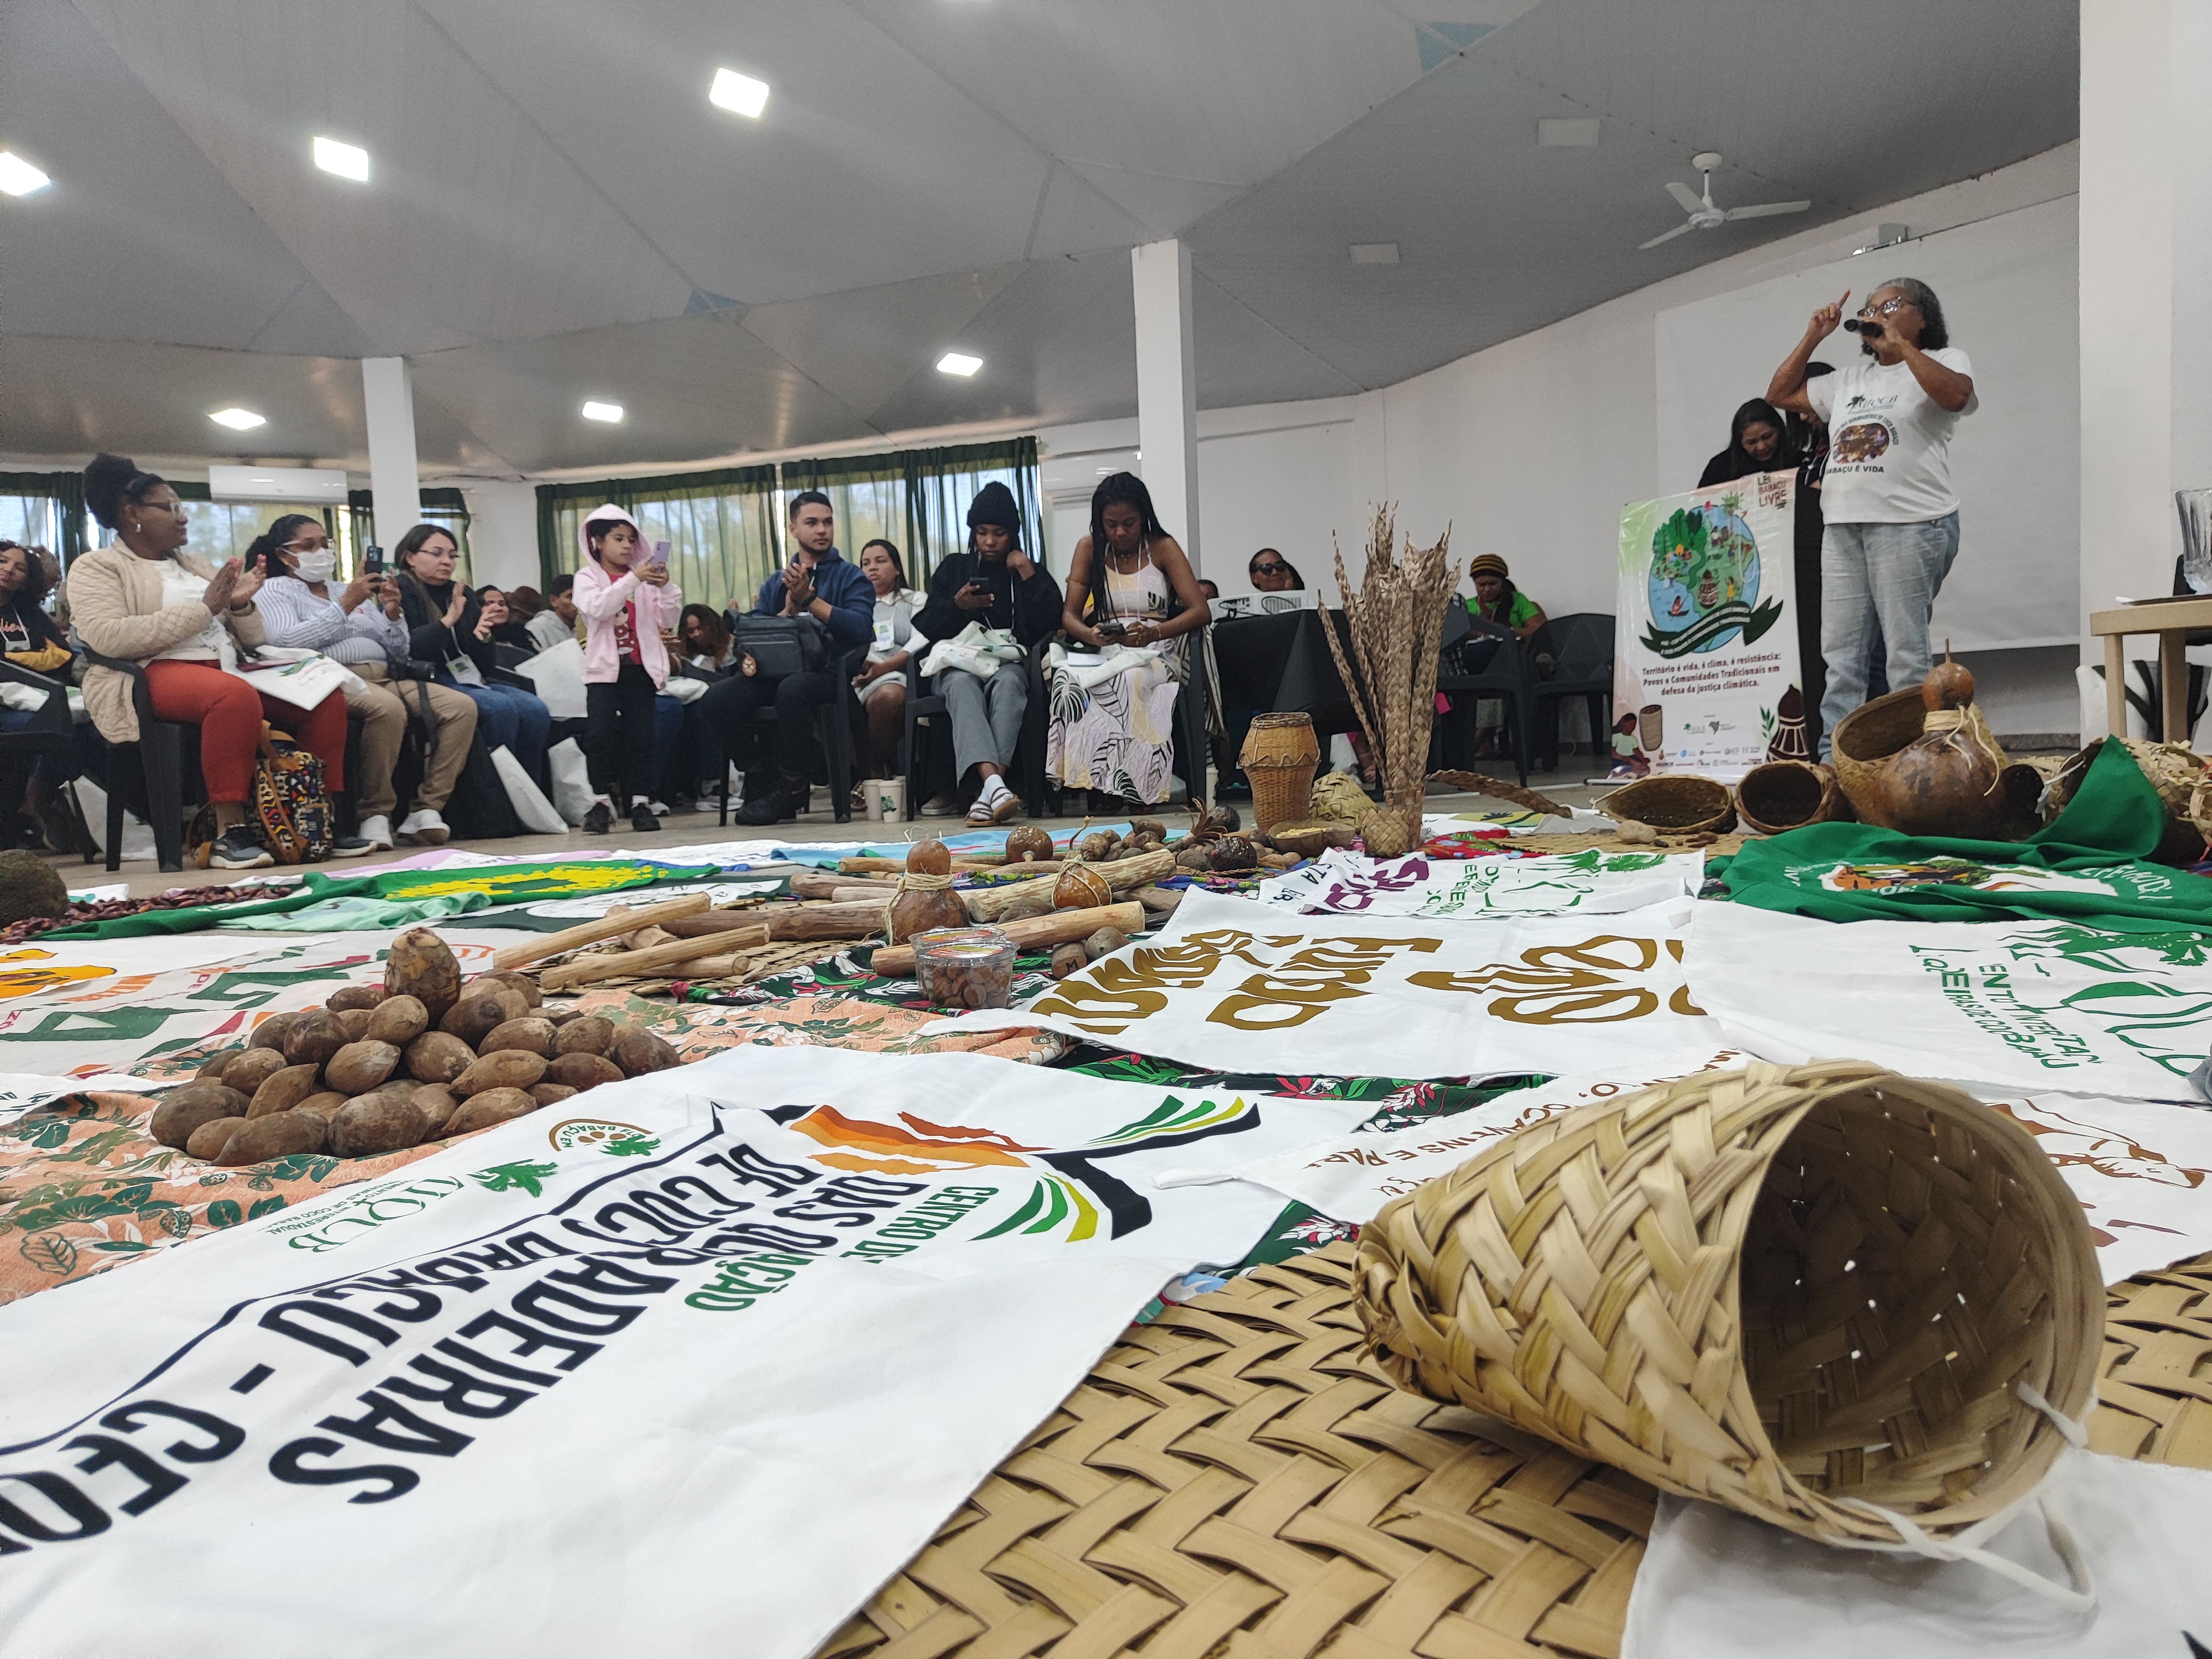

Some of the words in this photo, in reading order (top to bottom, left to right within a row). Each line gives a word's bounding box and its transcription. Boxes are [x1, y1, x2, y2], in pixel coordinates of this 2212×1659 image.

[1759, 489, 1787, 507] LIVRE
[1642, 665, 1674, 676] Território
[1643, 678, 1663, 686] Povos
[1671, 670, 1719, 684] Comunidades
[1721, 665, 1765, 678] Tradicionais
[1661, 686, 1684, 696] defesa
[1687, 685, 1695, 693] da
[1697, 683, 1721, 694] justiça
[1723, 679, 1759, 691] climática.
[1417, 1103, 1573, 1153] OCANTINS
[696, 1143, 825, 1198] DE
[774, 1175, 930, 1227] DAS
[300, 1208, 332, 1218] COCO
[876, 1186, 999, 1240] CENTRO
